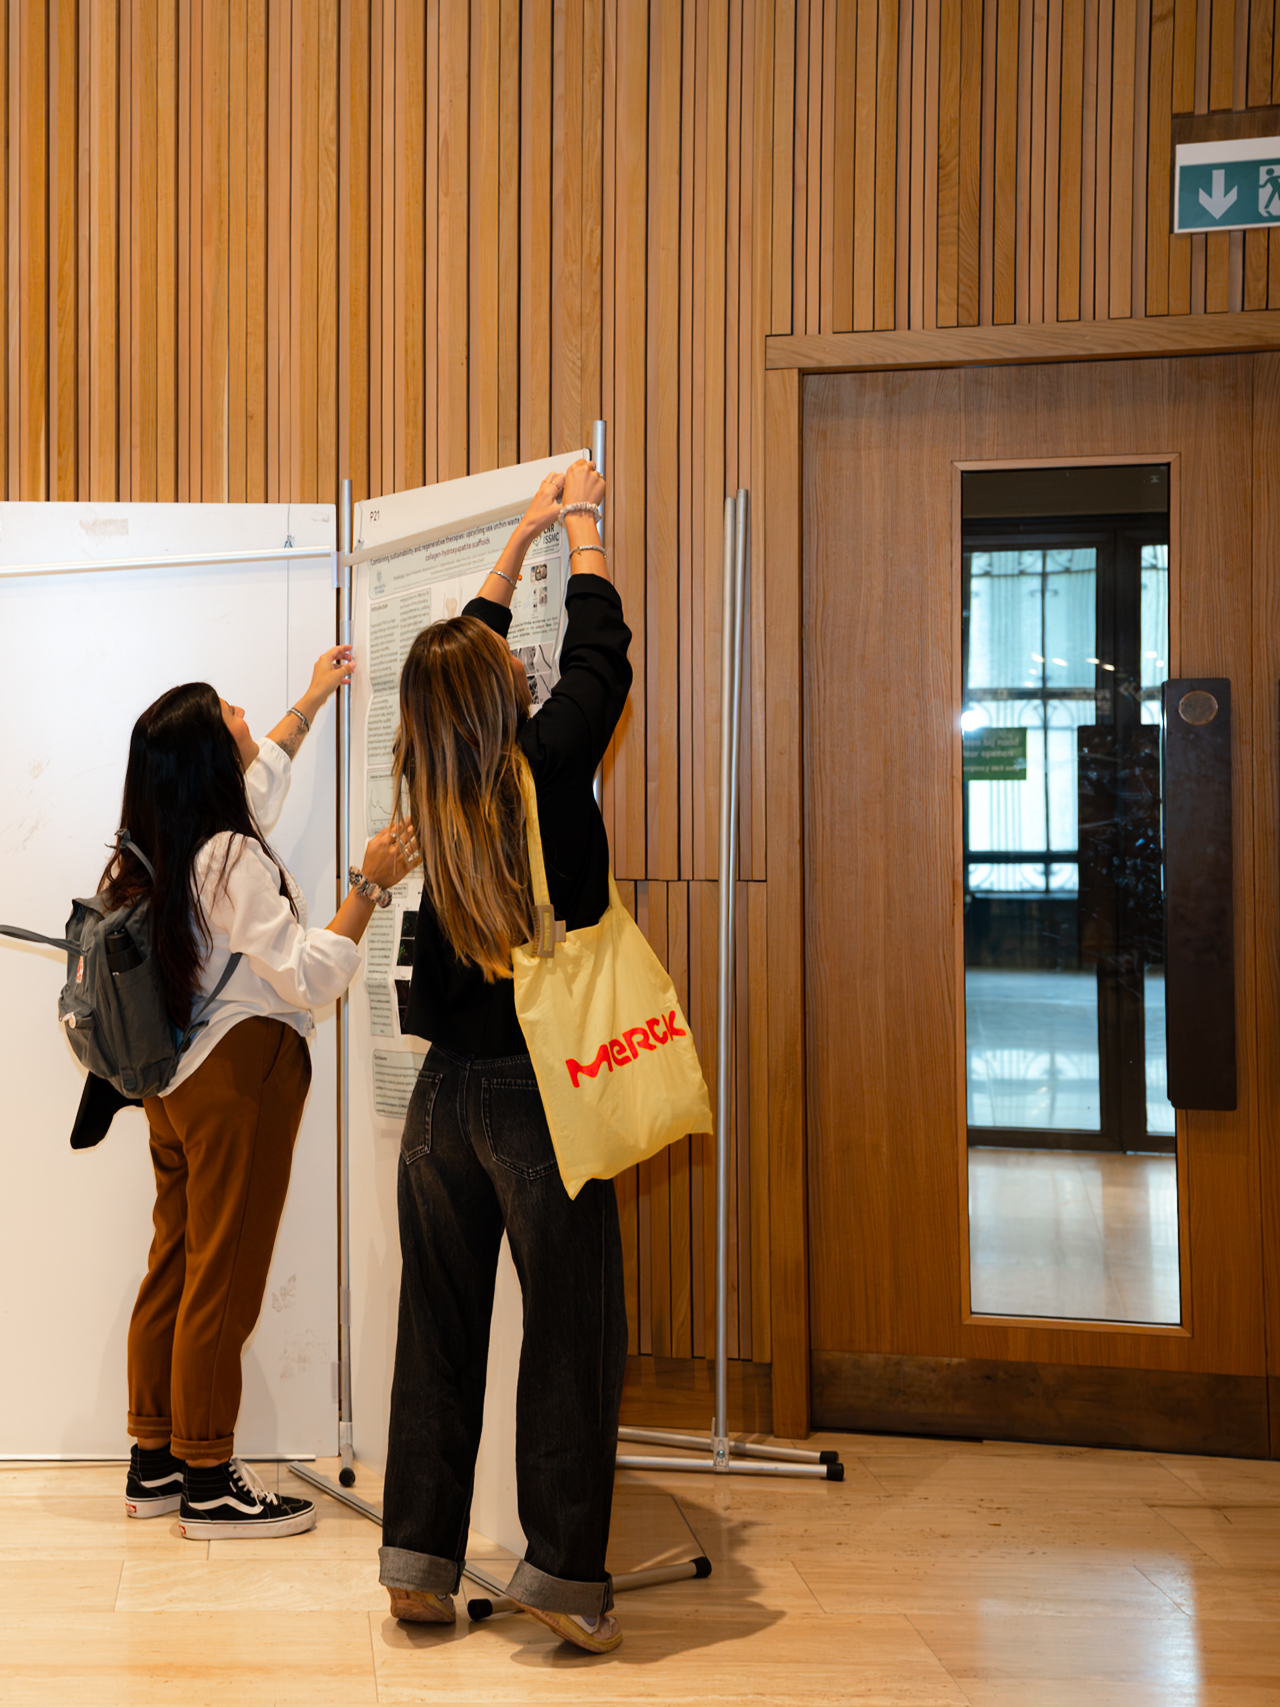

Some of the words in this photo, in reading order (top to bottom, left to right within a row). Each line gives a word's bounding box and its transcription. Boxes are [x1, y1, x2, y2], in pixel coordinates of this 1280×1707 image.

[370, 510, 381, 522] P21
[370, 555, 390, 566] Combining
[414, 545, 422, 553] and
[508, 517, 520, 526] waste
